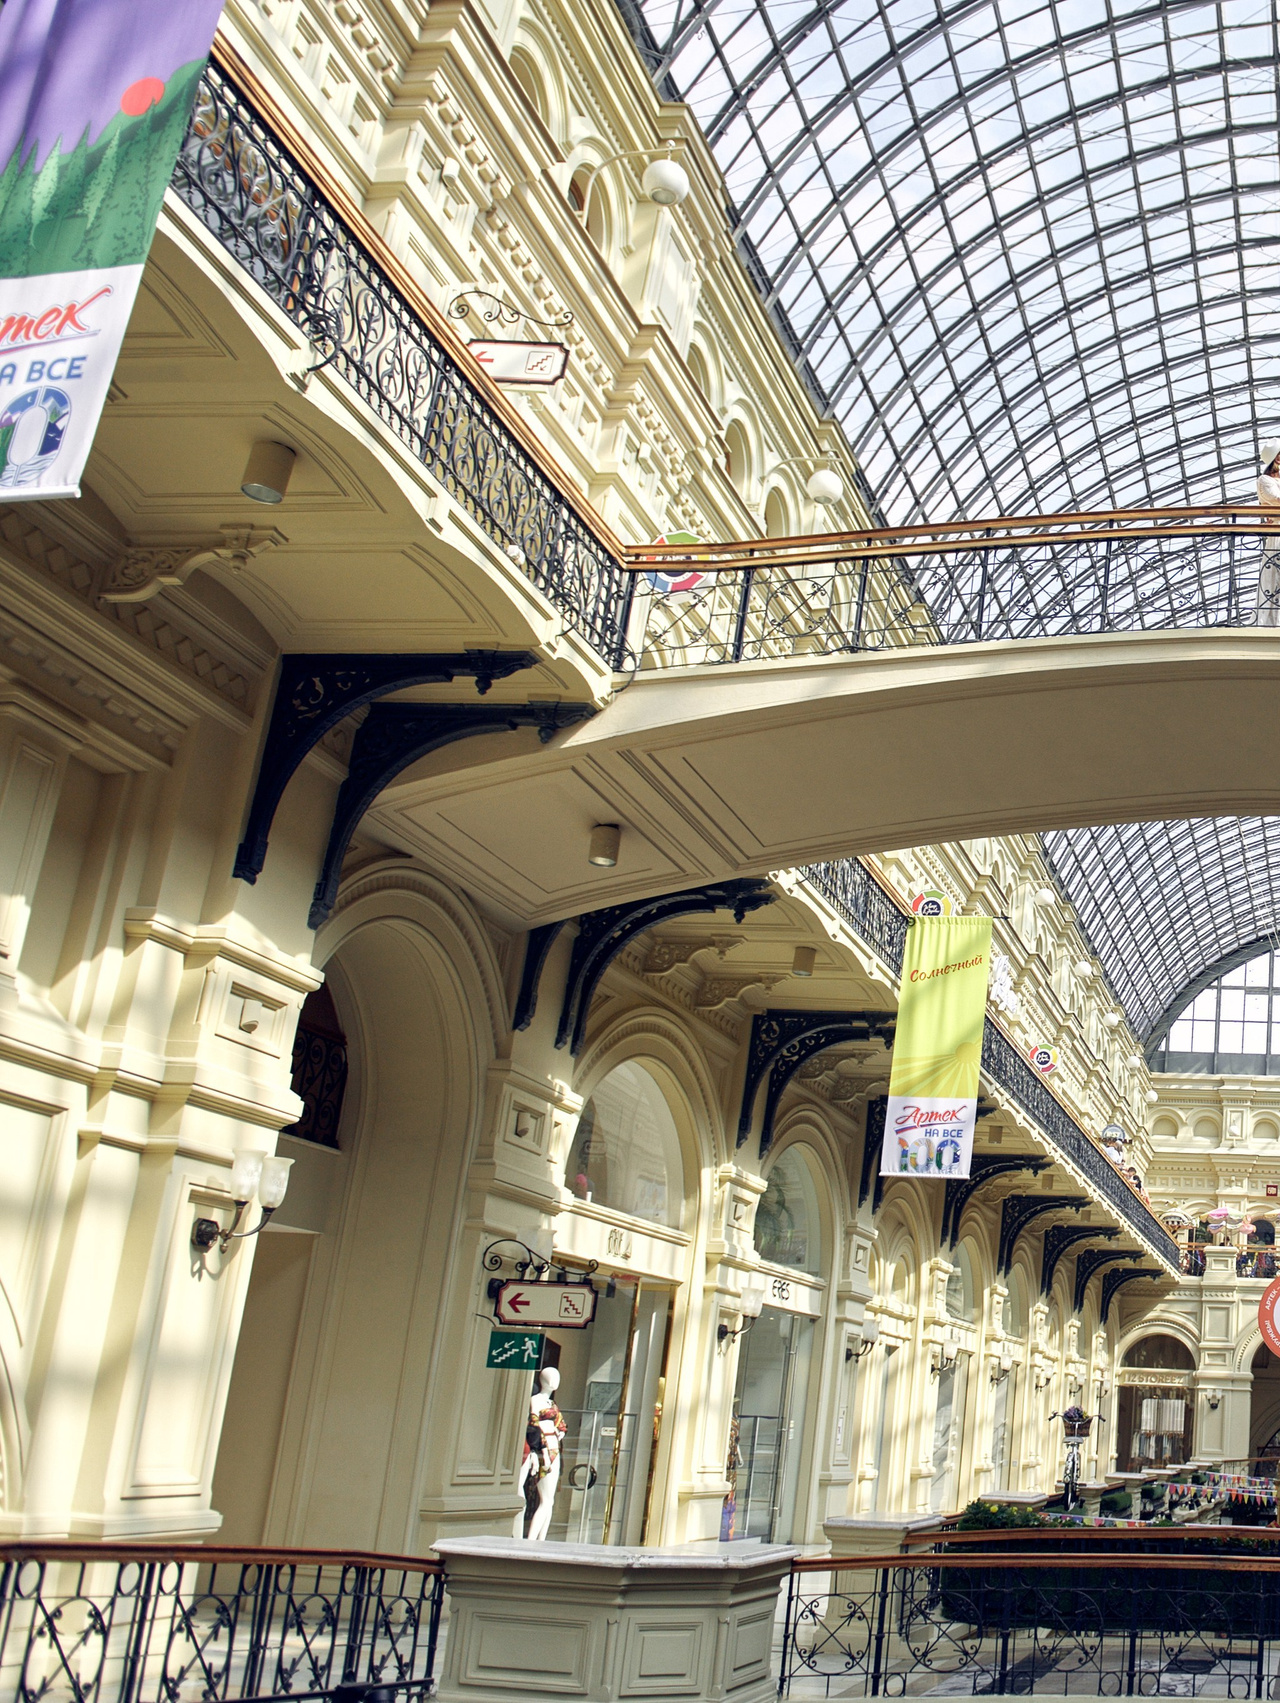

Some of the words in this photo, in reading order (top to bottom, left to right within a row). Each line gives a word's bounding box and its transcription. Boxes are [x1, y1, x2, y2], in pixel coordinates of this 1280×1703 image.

[26, 355, 88, 384] ВСЕ
[910, 954, 983, 983] Солнечный
[895, 1105, 968, 1128] Артек
[924, 1128, 939, 1138] НА
[943, 1129, 964, 1138] ВСЕ
[898, 1137, 961, 1173] 100
[772, 1279, 791, 1301] ERES
[1265, 1289, 1278, 1310] АРТЕК
